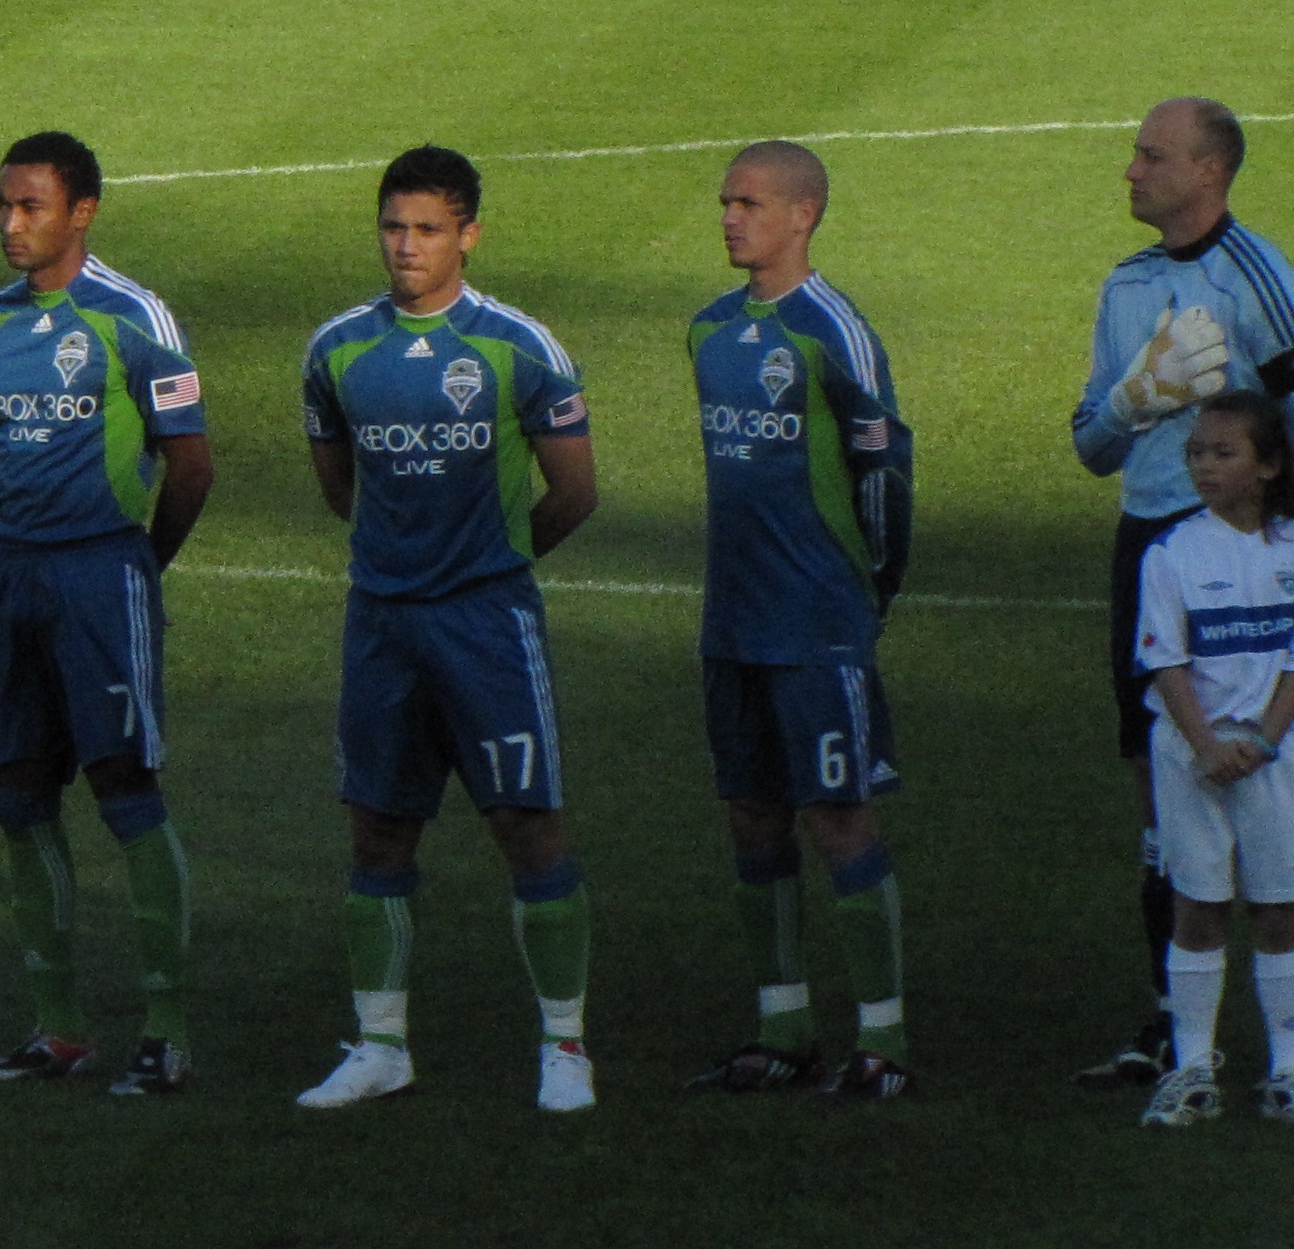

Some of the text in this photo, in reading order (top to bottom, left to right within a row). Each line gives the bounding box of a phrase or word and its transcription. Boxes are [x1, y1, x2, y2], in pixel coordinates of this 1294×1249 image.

[43, 393, 95, 421] 360
[9, 426, 53, 443] LIVE
[352, 421, 491, 452] XBOX 360
[745, 410, 800, 442] 360
[392, 458, 447, 476] LIVE
[104, 683, 135, 738] 7
[479, 732, 534, 793] 17
[819, 730, 847, 789] 6
